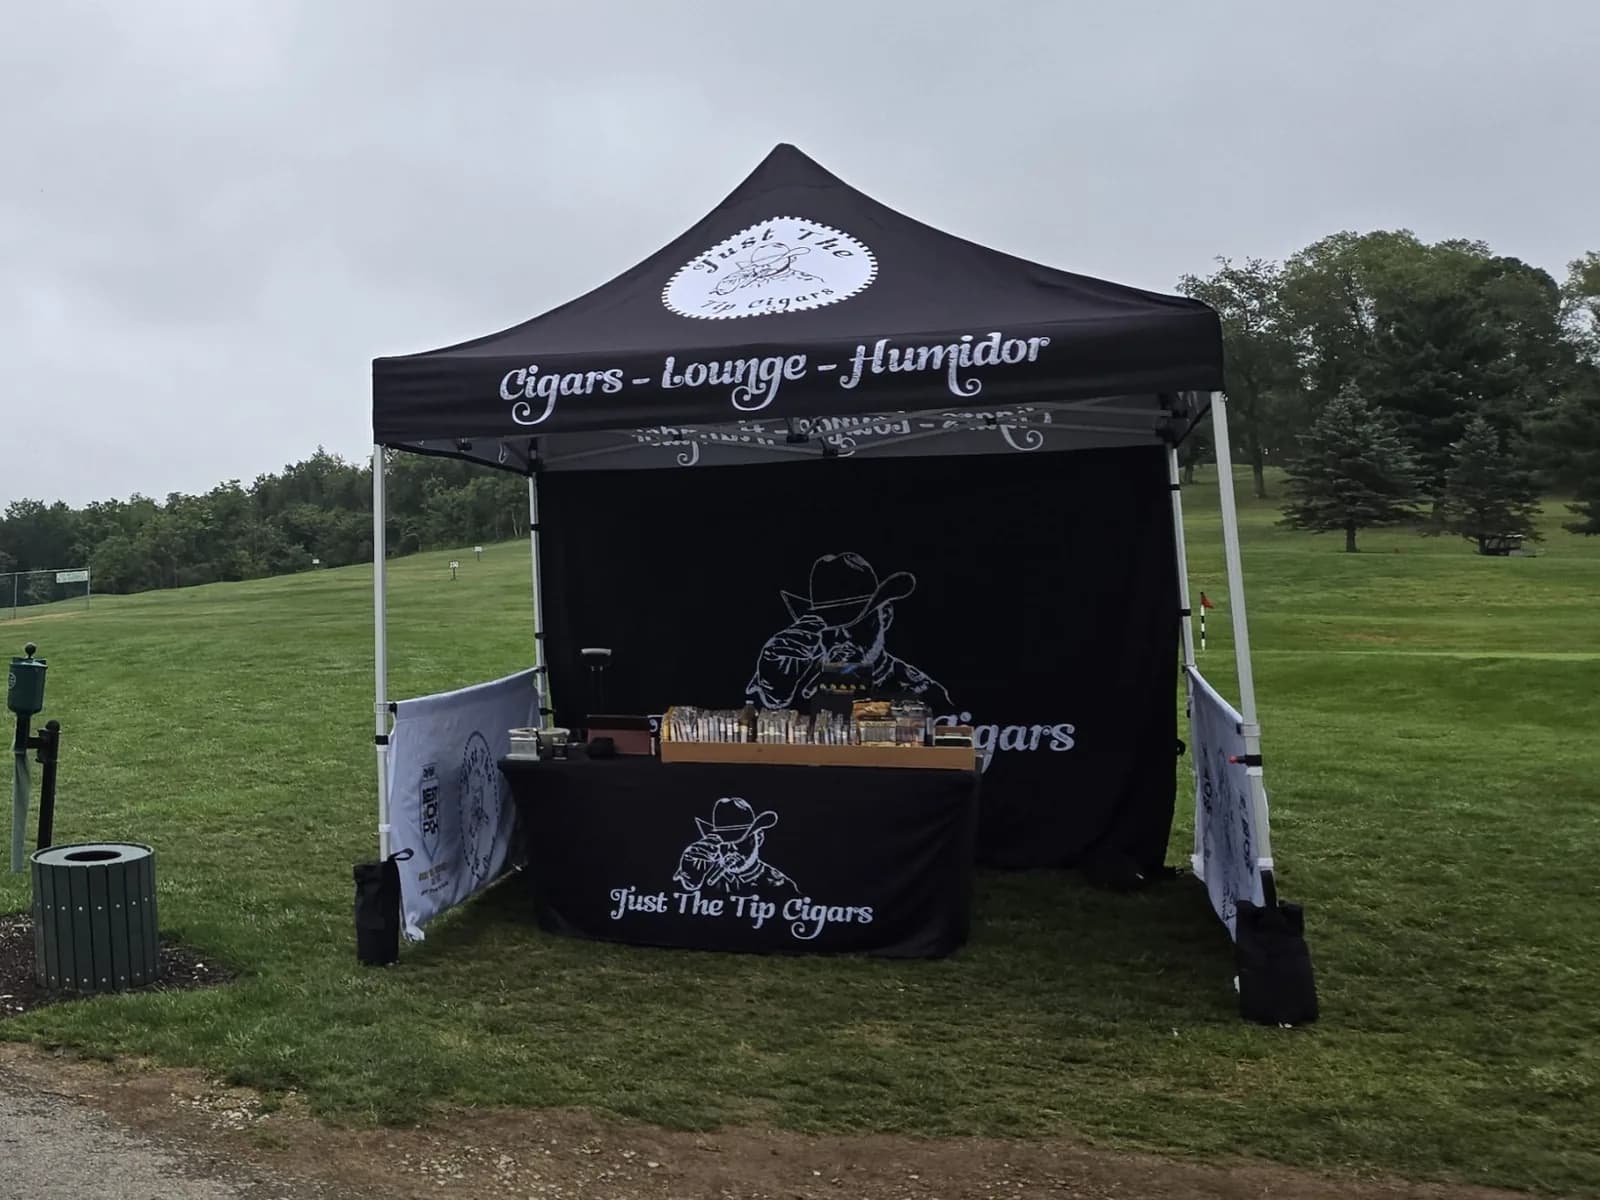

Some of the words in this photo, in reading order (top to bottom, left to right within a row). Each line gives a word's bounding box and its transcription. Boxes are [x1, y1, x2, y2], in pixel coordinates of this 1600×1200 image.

[693, 227, 775, 273] Just
[798, 228, 854, 259] The
[700, 299, 737, 313] Tip
[747, 288, 835, 312] Cigars
[499, 364, 623, 425] Cigars
[661, 356, 807, 410] Lounge
[839, 331, 1050, 396] Humidor
[926, 711, 1075, 774] gars
[610, 886, 669, 919] Just
[673, 891, 724, 916] The
[730, 894, 776, 929] Tip
[783, 897, 873, 940] Cigars
